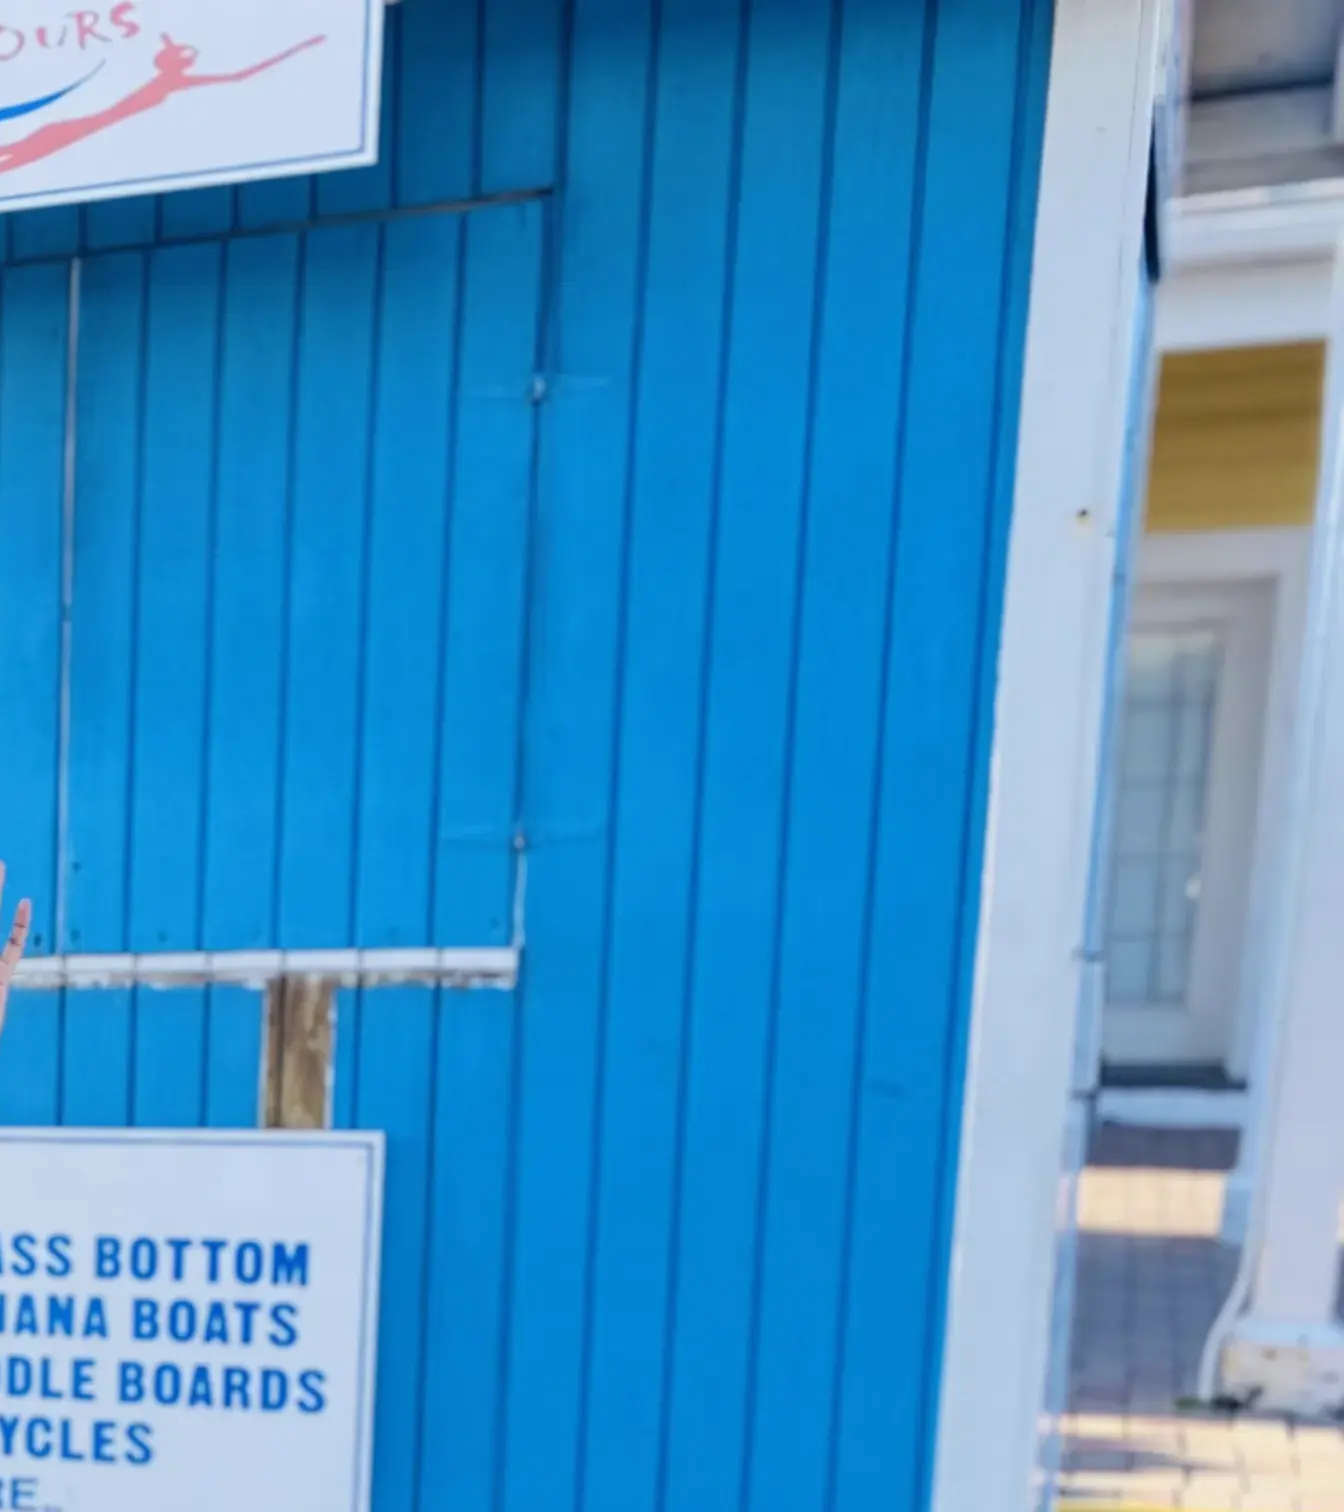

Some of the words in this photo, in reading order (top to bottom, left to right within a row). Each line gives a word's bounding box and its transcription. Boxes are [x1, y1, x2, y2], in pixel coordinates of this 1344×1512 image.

[93, 1238, 309, 1286] BOTTOM
[133, 1301, 298, 1346] BOATS
[118, 1362, 328, 1413] BOARDS
